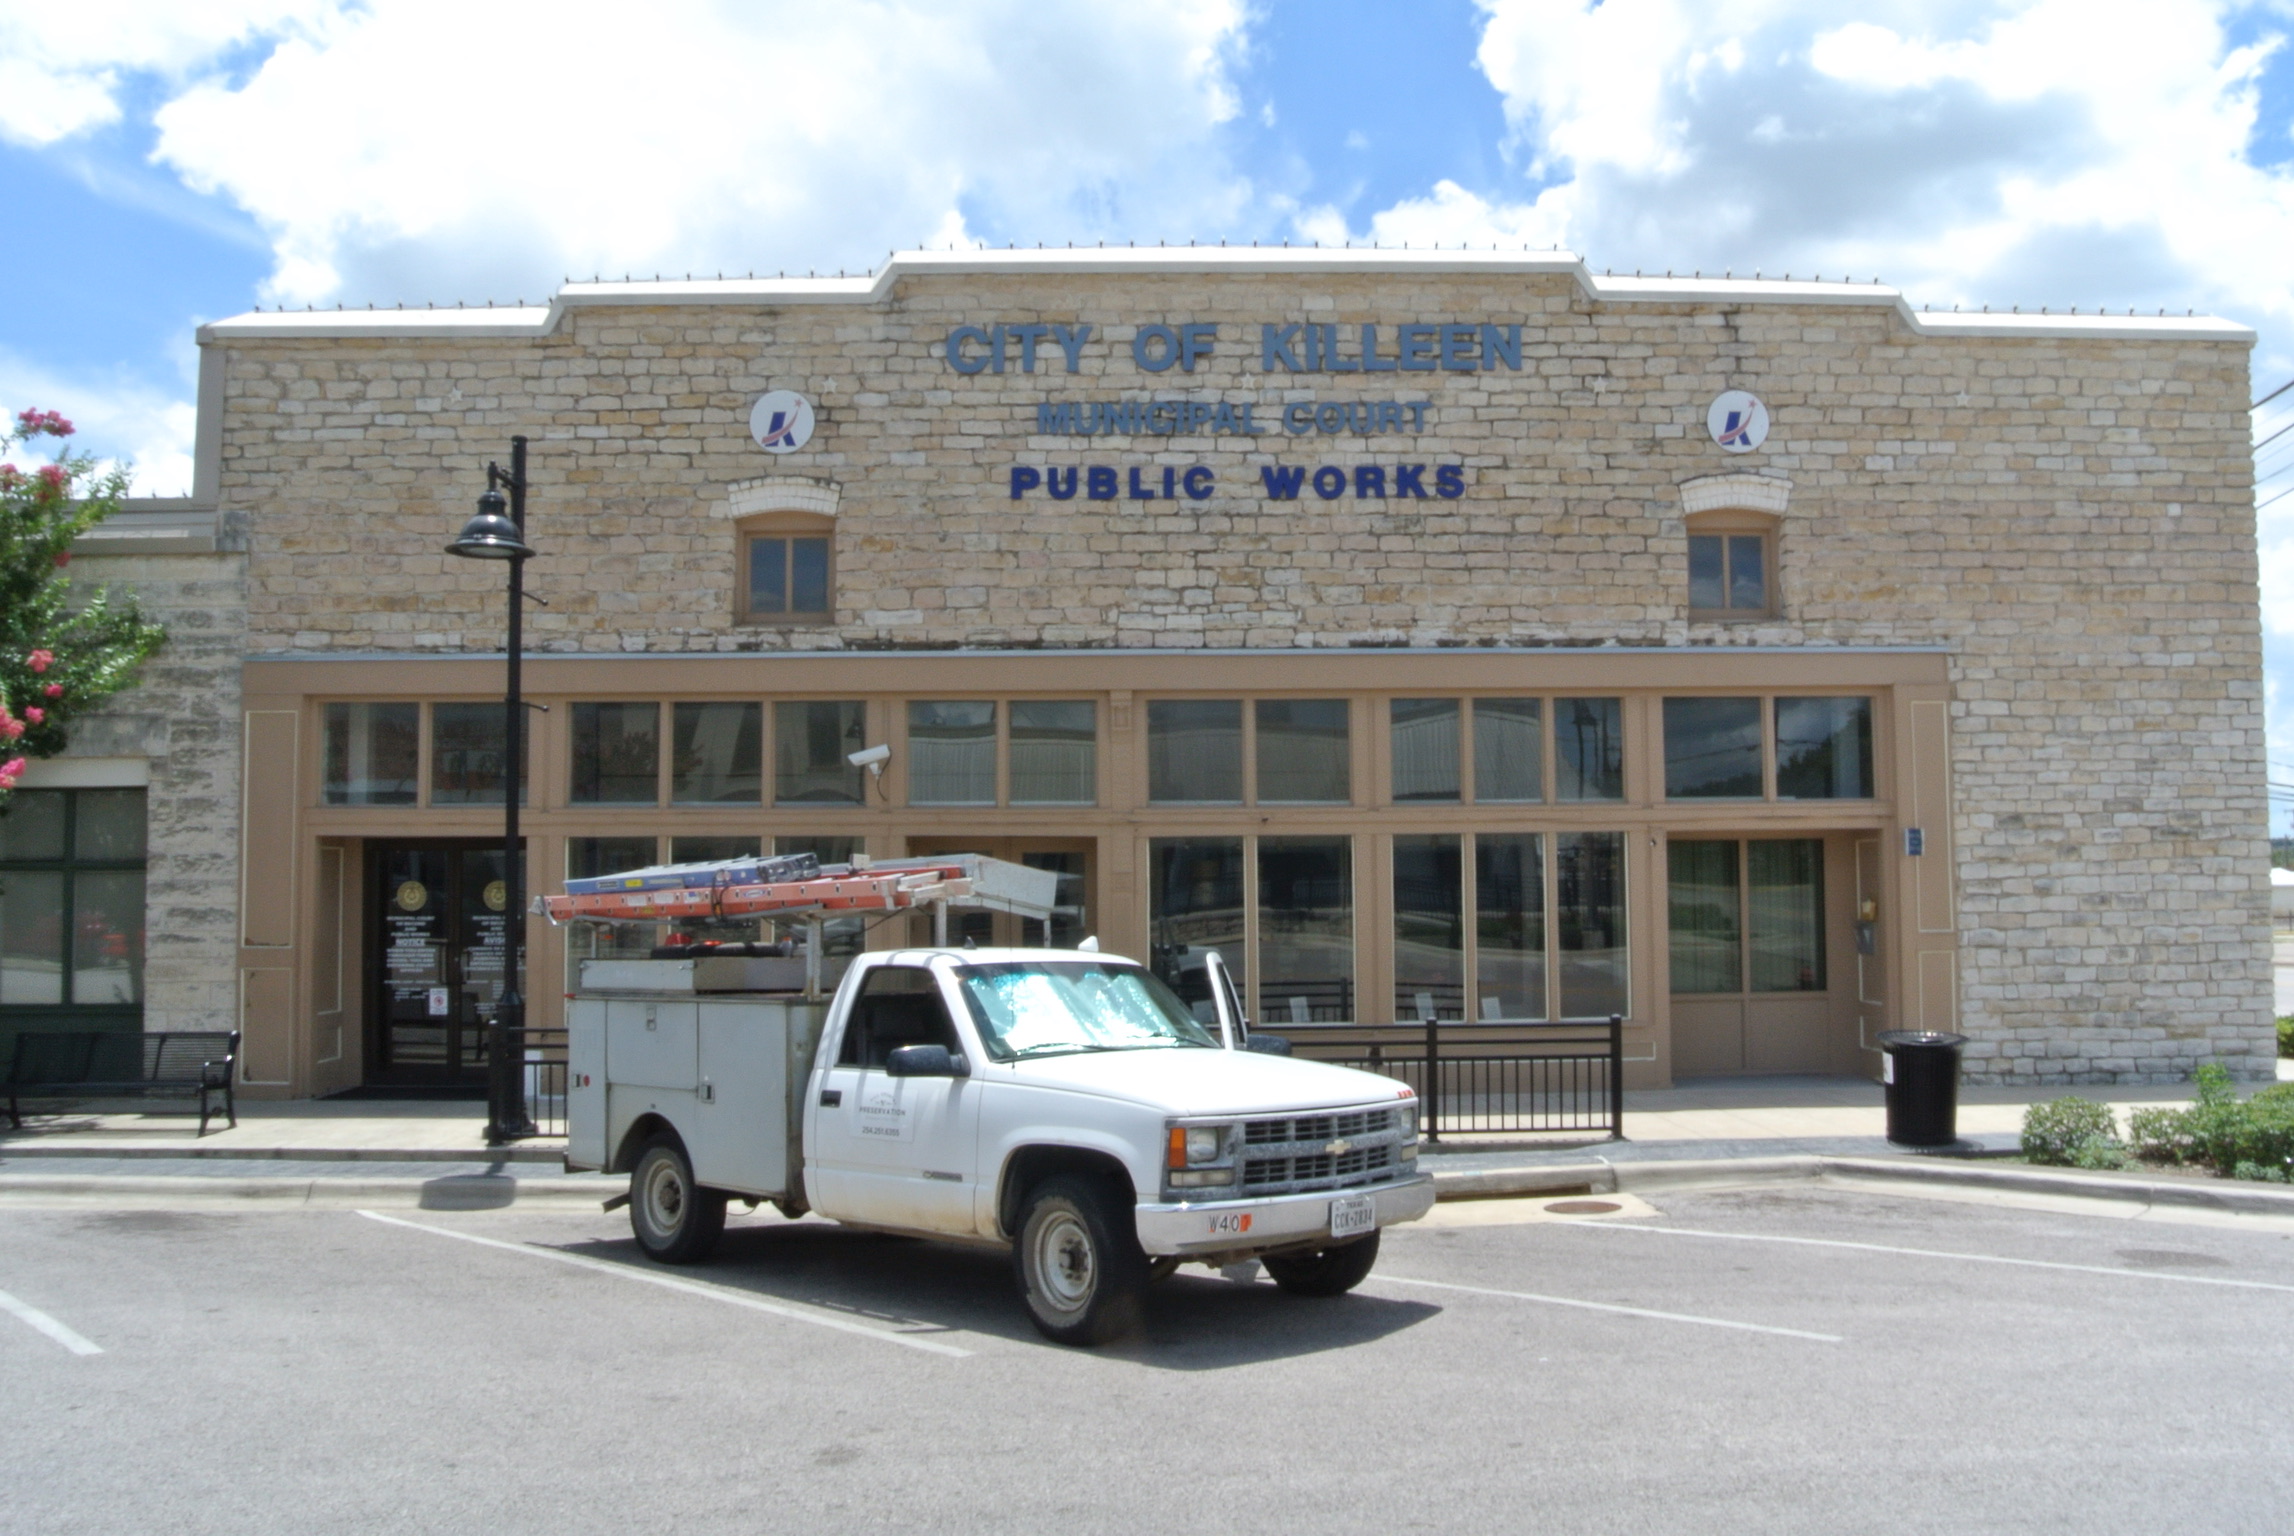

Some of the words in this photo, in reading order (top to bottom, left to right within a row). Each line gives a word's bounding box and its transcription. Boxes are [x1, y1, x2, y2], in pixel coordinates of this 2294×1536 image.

[946, 324, 1093, 374] CITY
[1132, 323, 1217, 373] OF
[1261, 323, 1522, 372] KILLEEN
[1036, 401, 1265, 435] MUNICIPAL
[1283, 401, 1432, 434] COURT
[1010, 465, 1215, 501] PUBLIC
[1261, 464, 1465, 501] WORKS
